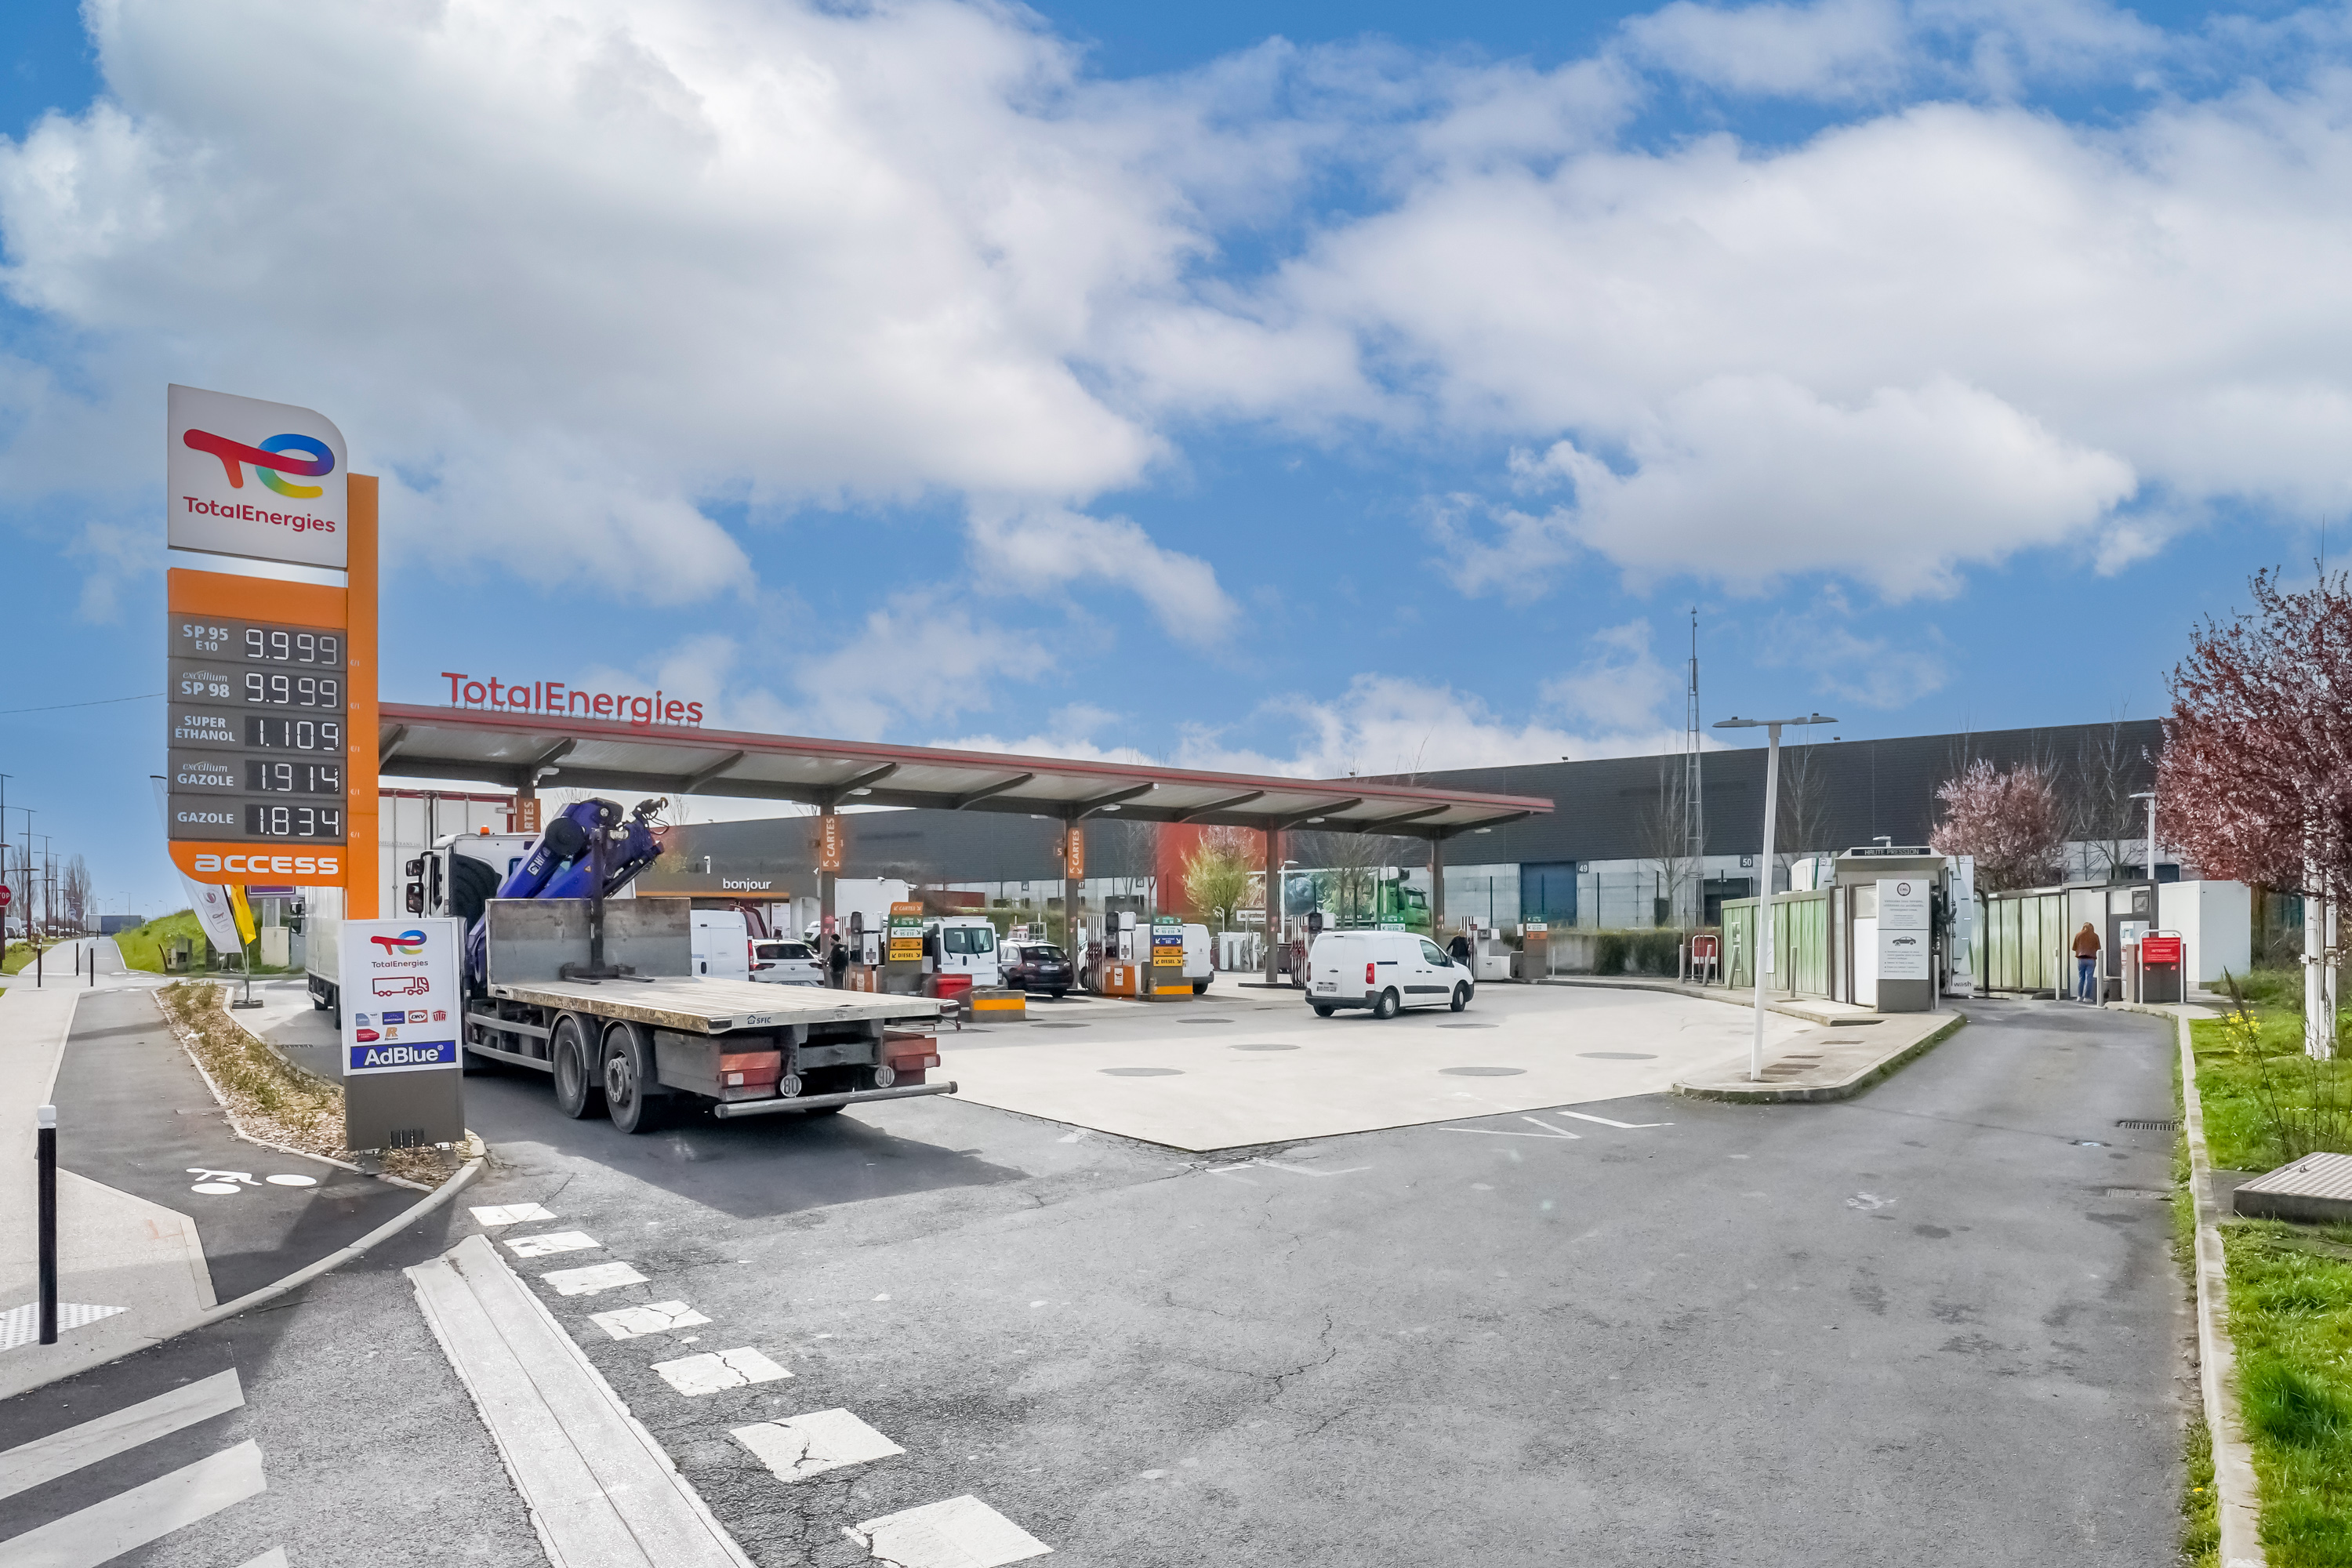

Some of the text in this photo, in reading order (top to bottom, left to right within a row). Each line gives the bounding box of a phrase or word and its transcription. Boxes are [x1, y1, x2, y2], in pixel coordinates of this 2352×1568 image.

[183, 495, 336, 532] TotalEnergies
[183, 625, 229, 641] SP 95
[195, 641, 218, 652] E10
[245, 629, 337, 665] 9.999
[182, 670, 227, 682] excellium
[182, 681, 230, 697] SP 98
[245, 673, 337, 708] 9.999
[441, 672, 702, 726] TotalEnergies
[184, 715, 226, 728] SUPER
[175, 726, 235, 742] ÉTHANOL
[260, 720, 339, 751] 1.109
[182, 761, 228, 772] excellium
[176, 774, 234, 786] GAZOLE
[176, 812, 234, 824] GAZOLE
[260, 807, 339, 837] 1.834
[524, 801, 534, 833] RTES
[826, 817, 835, 857] CARTES
[723, 878, 771, 892] bonjour
[371, 960, 429, 968] TotalEnergies
[433, 1011, 446, 1021] UTA
[878, 1069, 892, 1085] 90
[783, 1078, 798, 1094] 80
